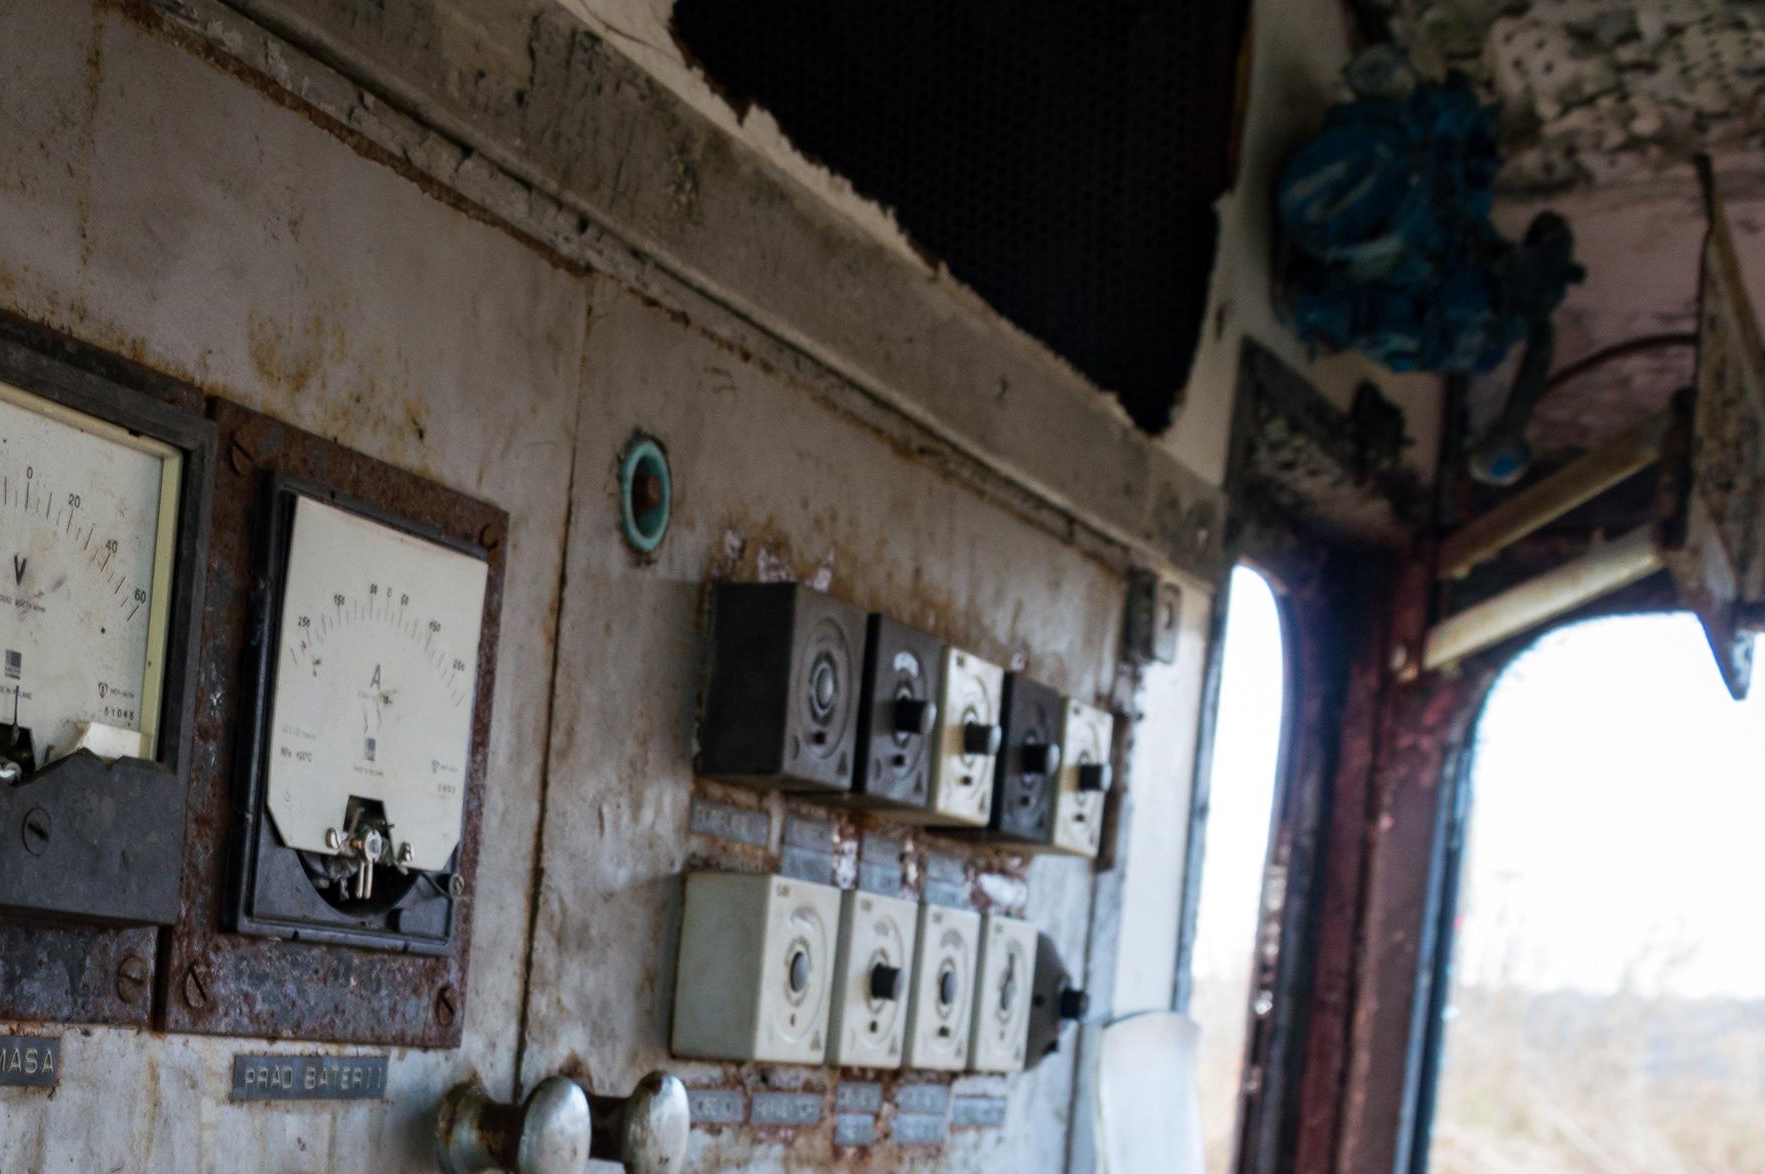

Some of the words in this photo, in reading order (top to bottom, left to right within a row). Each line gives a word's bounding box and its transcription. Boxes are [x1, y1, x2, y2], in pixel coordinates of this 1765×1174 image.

[26, 466, 34, 480] 0
[68, 493, 82, 509] 20
[105, 539, 119, 554] 40
[13, 555, 27, 586] V
[134, 588, 148, 604] 60
[370, 663, 382, 690] A
[245, 1064, 294, 1091] PRAD
[304, 1065, 384, 1091] BATERII
